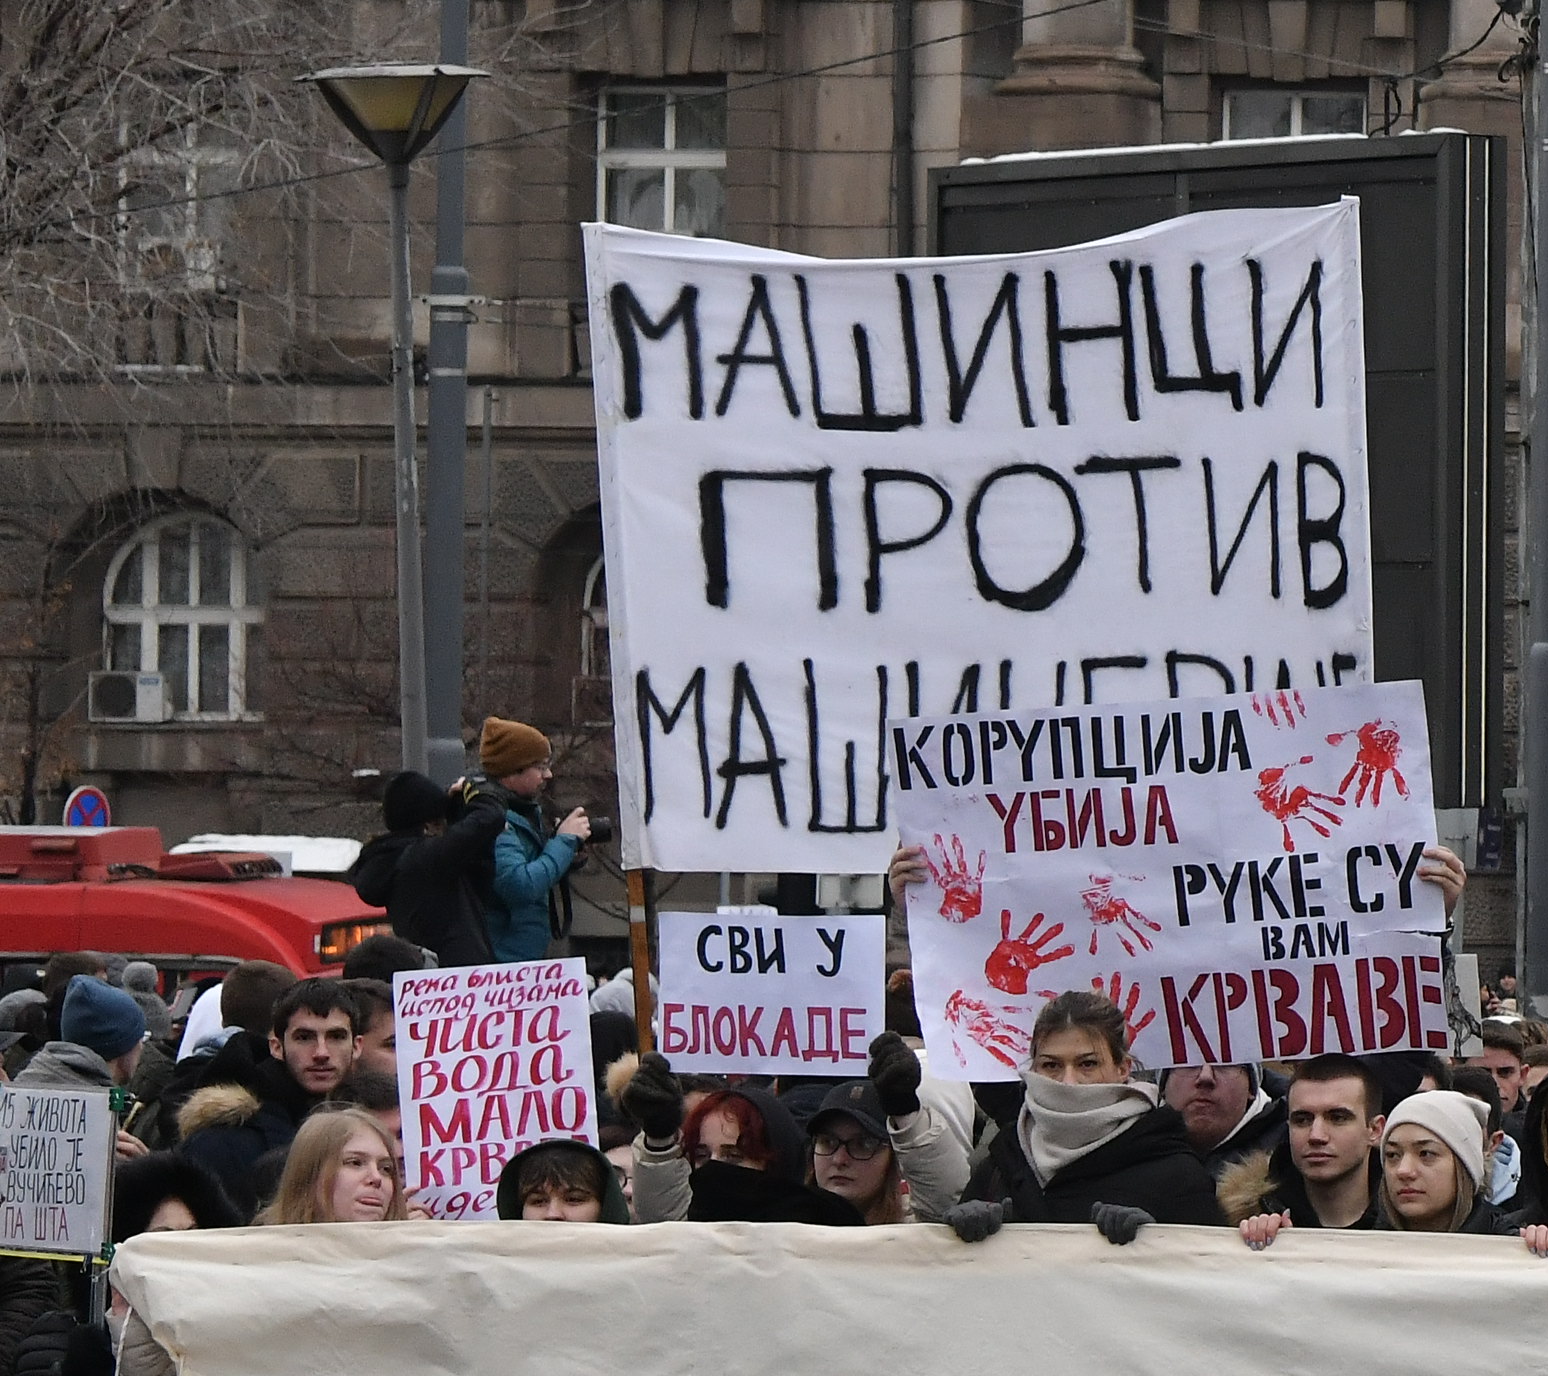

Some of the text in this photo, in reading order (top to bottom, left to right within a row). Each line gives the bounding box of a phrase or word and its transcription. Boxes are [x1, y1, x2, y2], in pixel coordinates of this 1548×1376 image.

[611, 257, 1325, 432] МАШИНЦИ
[698, 452, 1349, 614] ПРОТИВ
[891, 709, 1252, 791] КОРУПЦИЈА
[985, 784, 1180, 854] УБИЈА
[1172, 841, 1426, 926] РУКЕ СУ
[697, 925, 846, 977] СВИ У
[1261, 921, 1351, 962] ВАМ
[662, 1003, 867, 1063] БЛОКАДЕ
[1160, 955, 1448, 1065] КРВАВЕ
[20, 1096, 86, 1134] ЖИВОТА
[419, 1086, 587, 1147] МАЛО
[9, 1134, 56, 1171] УБИЛО
[66, 1138, 84, 1172] ЈЕ
[6, 1170, 85, 1205] ВУЧИЋЕВО
[4, 1206, 69, 1241] ПА ШТА
